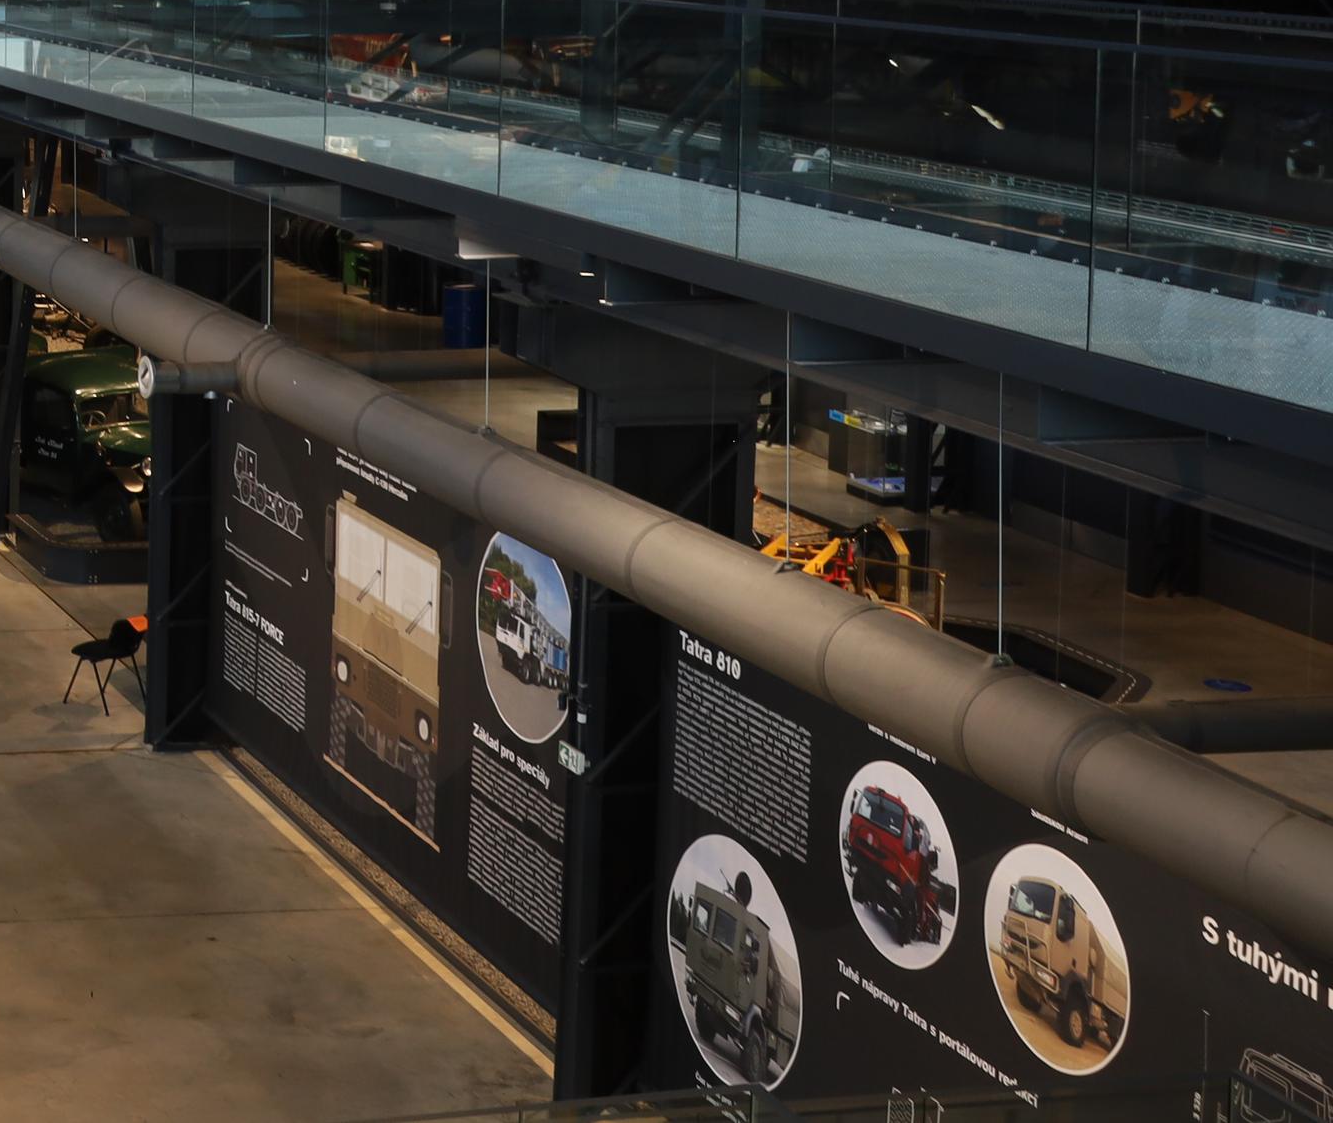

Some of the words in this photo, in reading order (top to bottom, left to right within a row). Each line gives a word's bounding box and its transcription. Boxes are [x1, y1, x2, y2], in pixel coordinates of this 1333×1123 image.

[224, 590, 241, 615] Tatra
[260, 616, 285, 646] FORCE
[679, 629, 713, 666] Tatra
[716, 650, 742, 680] 810
[472, 722, 500, 753] Základ
[500, 744, 515, 764] pro
[516, 754, 551, 791] speciály
[1201, 915, 1220, 945] S
[1226, 929, 1319, 1002] tuhými
[836, 957, 860, 984] Tuhé
[861, 977, 900, 1013] nápravy
[901, 1001, 928, 1031] Tatra
[929, 1024, 937, 1037] s
[939, 1030, 996, 1078] portálovou
[998, 1070, 1039, 1109] redkcí
